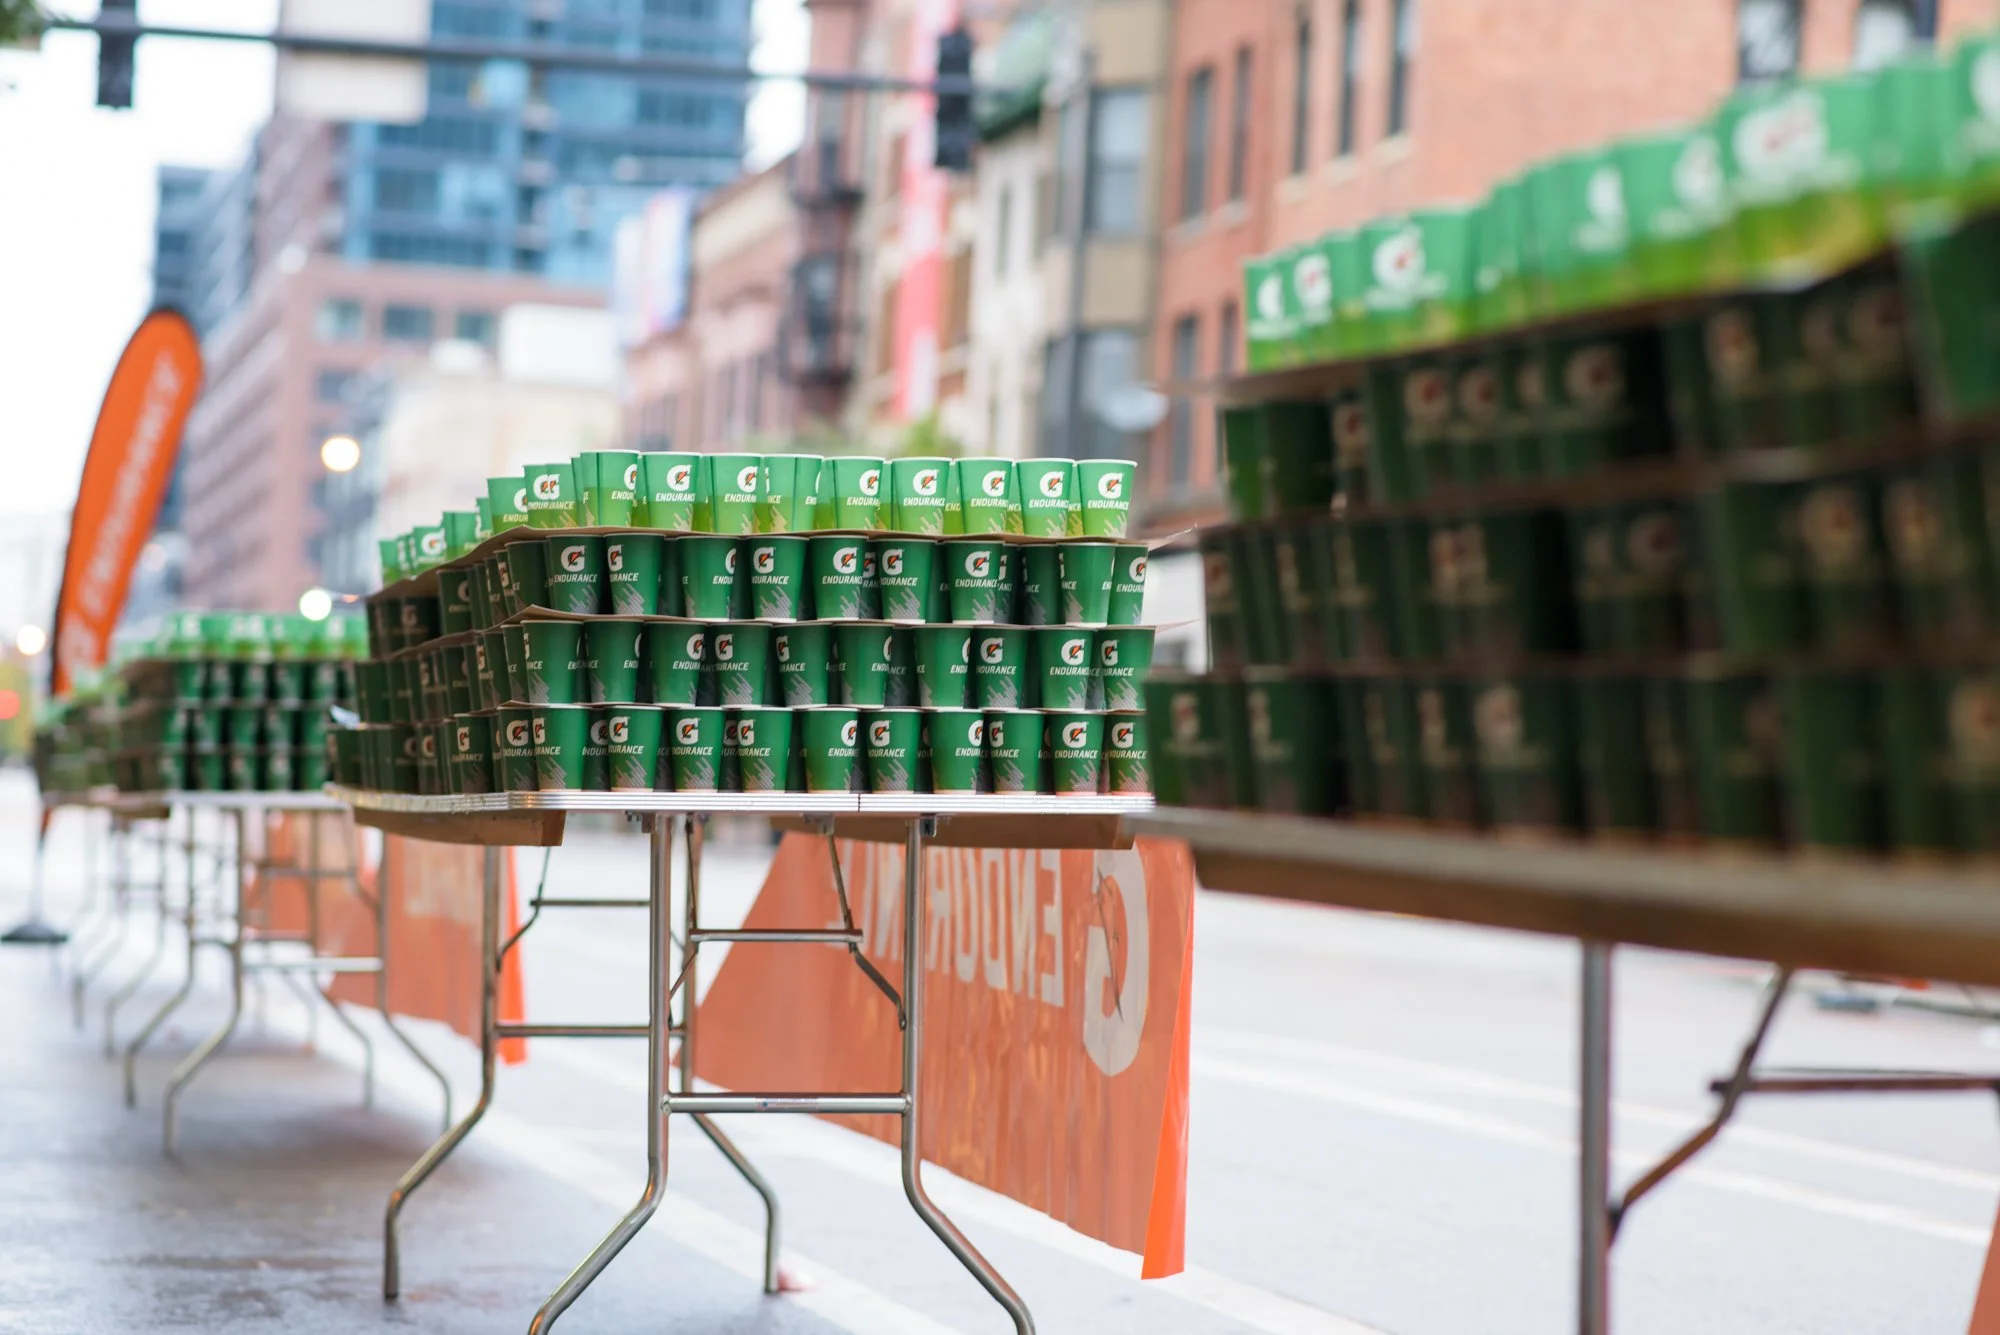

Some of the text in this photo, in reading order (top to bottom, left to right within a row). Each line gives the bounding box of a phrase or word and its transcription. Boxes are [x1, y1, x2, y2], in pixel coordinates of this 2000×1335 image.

[666, 465, 692, 491] G
[913, 469, 939, 496] G
[982, 470, 1006, 497] G
[1040, 471, 1065, 498] G
[1098, 473, 1124, 499] G
[561, 545, 586, 572] G
[753, 547, 775, 574] G
[833, 547, 858, 574] G
[882, 549, 903, 576] G
[965, 551, 990, 578] G
[715, 634, 734, 661] G
[980, 637, 1003, 664] G
[1061, 639, 1086, 666] G
[1101, 640, 1118, 666] G
[506, 720, 529, 747] G
[609, 716, 629, 743] G
[676, 717, 700, 745] G
[738, 719, 755, 746] G
[869, 720, 891, 747] G
[1062, 722, 1088, 748] G
[1112, 722, 1135, 749] G
[1055, 750, 1098, 759] ENDURANCE
